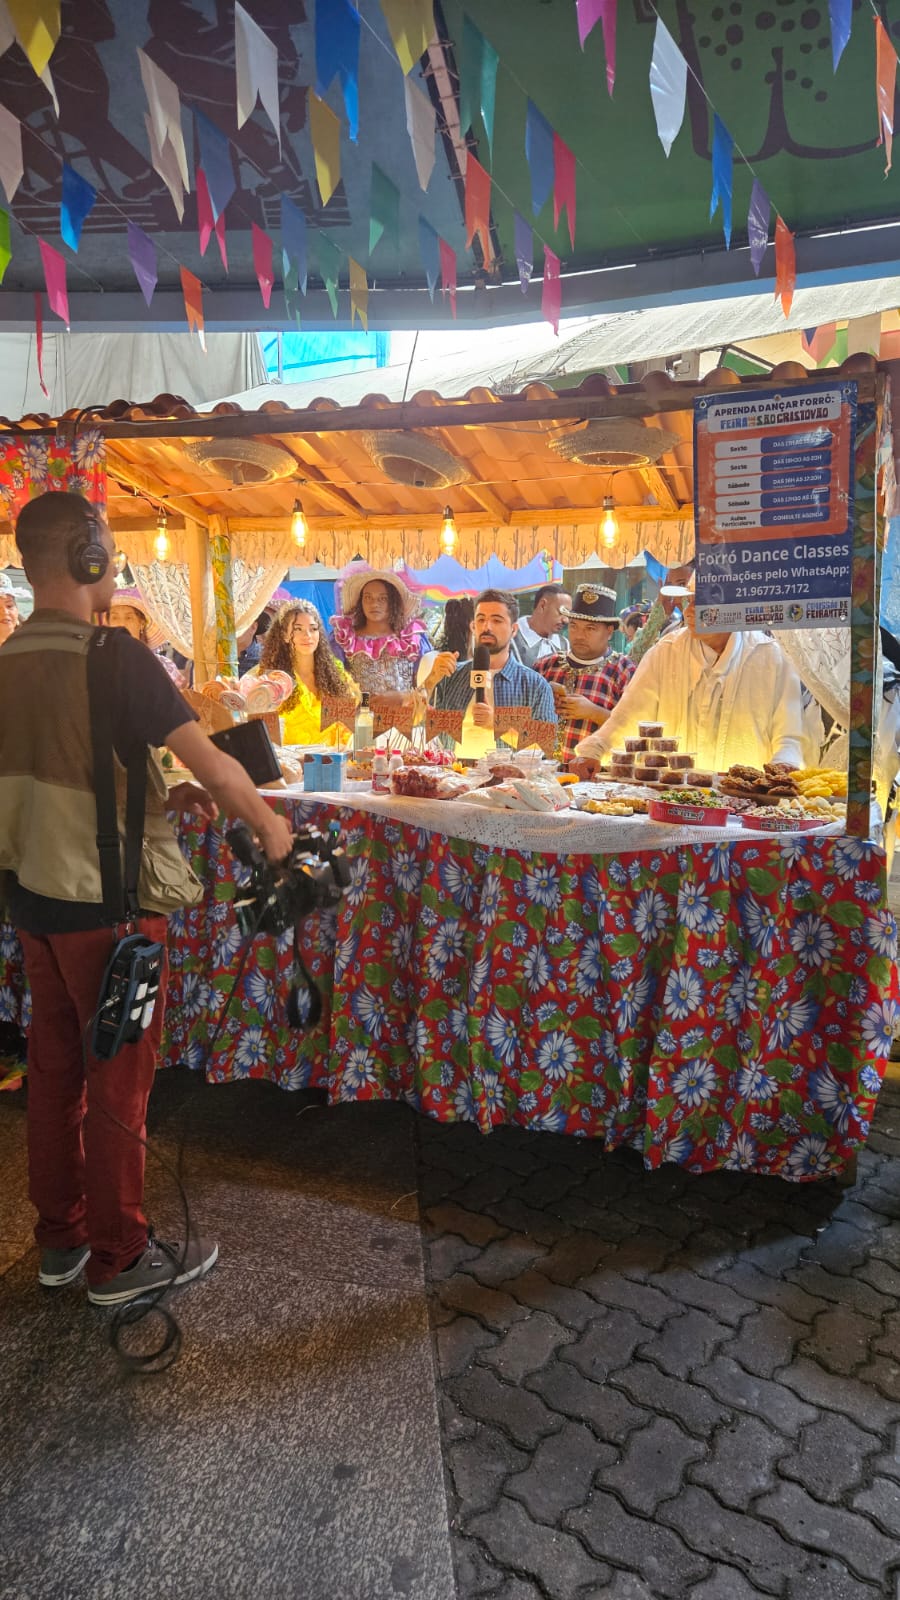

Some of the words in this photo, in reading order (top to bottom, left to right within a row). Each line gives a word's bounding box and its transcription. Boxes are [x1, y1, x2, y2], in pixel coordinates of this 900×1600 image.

[714, 405, 757, 417] APRENDA
[759, 399, 798, 413] DANÇAR
[720, 418, 748, 430] FEIRA
[756, 414, 776, 426] SÃO
[730, 445, 748, 453] Sexta
[773, 440, 785, 448] DAS
[772, 512, 801, 521] CONSULTE
[698, 550, 737, 566] Forró
[741, 549, 789, 563] Dance
[793, 544, 849, 559] Classes
[698, 570, 763, 584] Informações
[765, 568, 789, 581] pelo
[791, 564, 850, 578] WhatsApp:
[735, 583, 810, 598] 21.96773.7172
[806, 608, 848, 620] FEIRANTES
